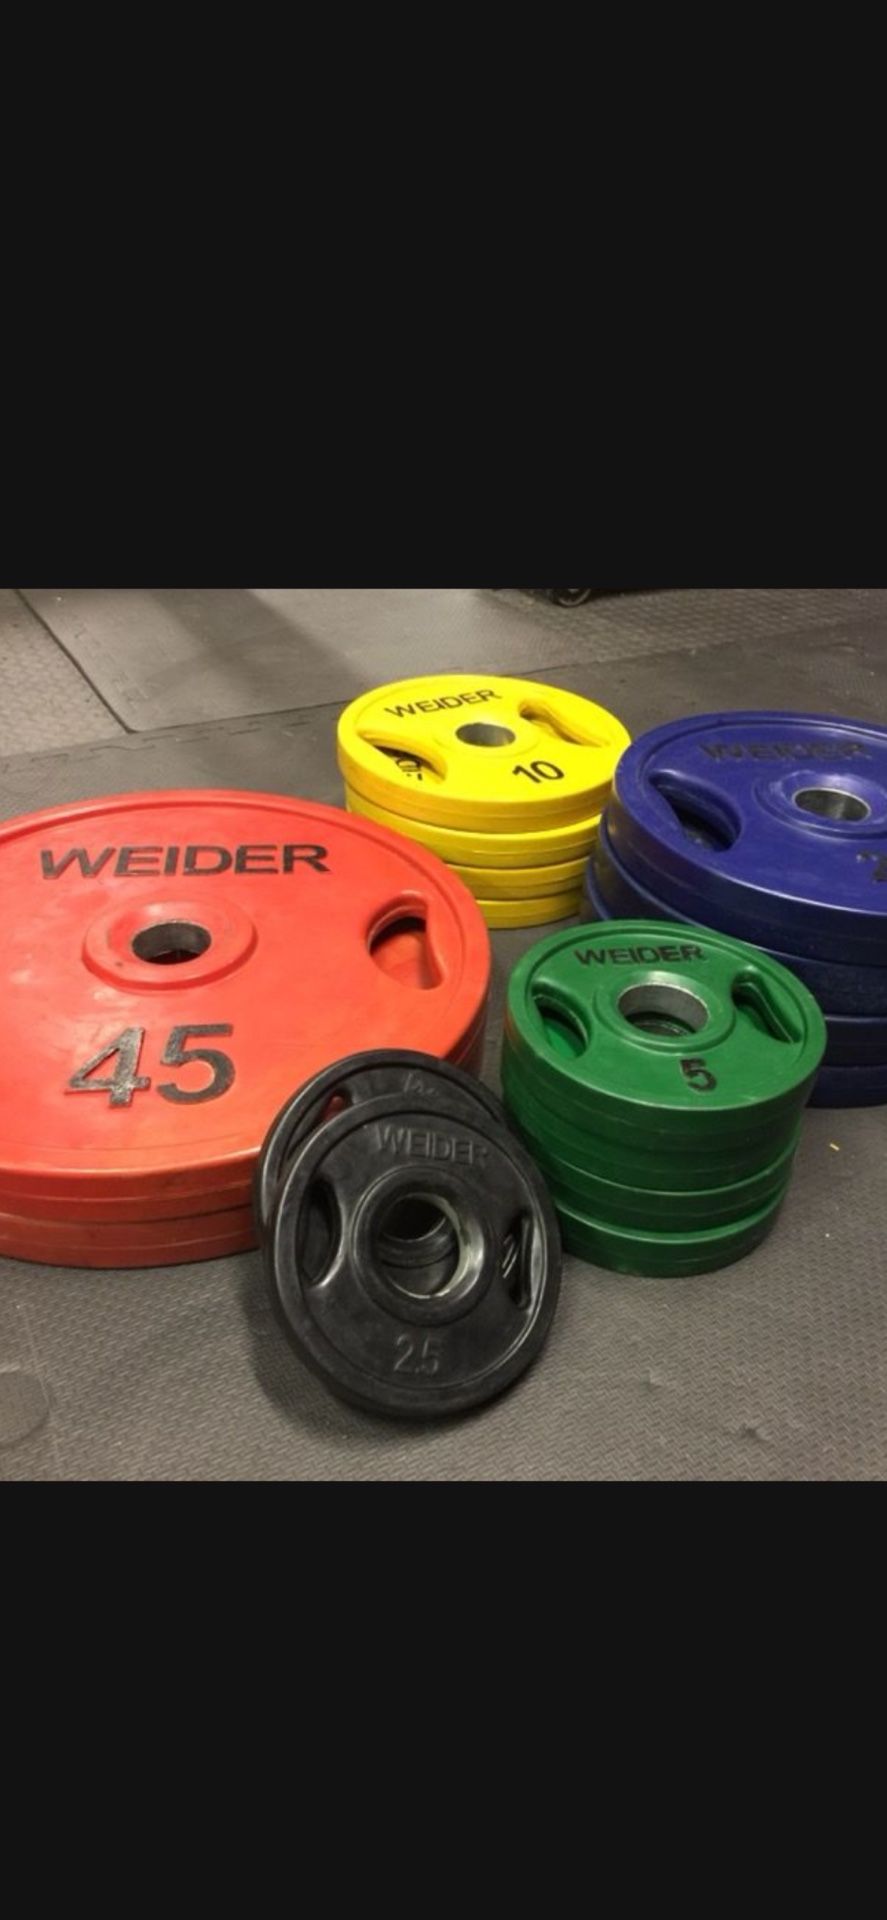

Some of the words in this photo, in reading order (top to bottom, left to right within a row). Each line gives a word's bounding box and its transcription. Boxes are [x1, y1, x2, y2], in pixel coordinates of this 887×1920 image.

[384, 689, 501, 717] WEIDER
[702, 741, 872, 760] WEIDER
[512, 760, 565, 783] 10
[41, 844, 330, 879] WEIDER
[573, 945, 705, 966] WEIDER
[66, 1023, 236, 1107] 45
[680, 1058, 717, 1093] 5
[374, 1125, 488, 1168] WEIDER
[394, 1334, 440, 1374] 2.5
